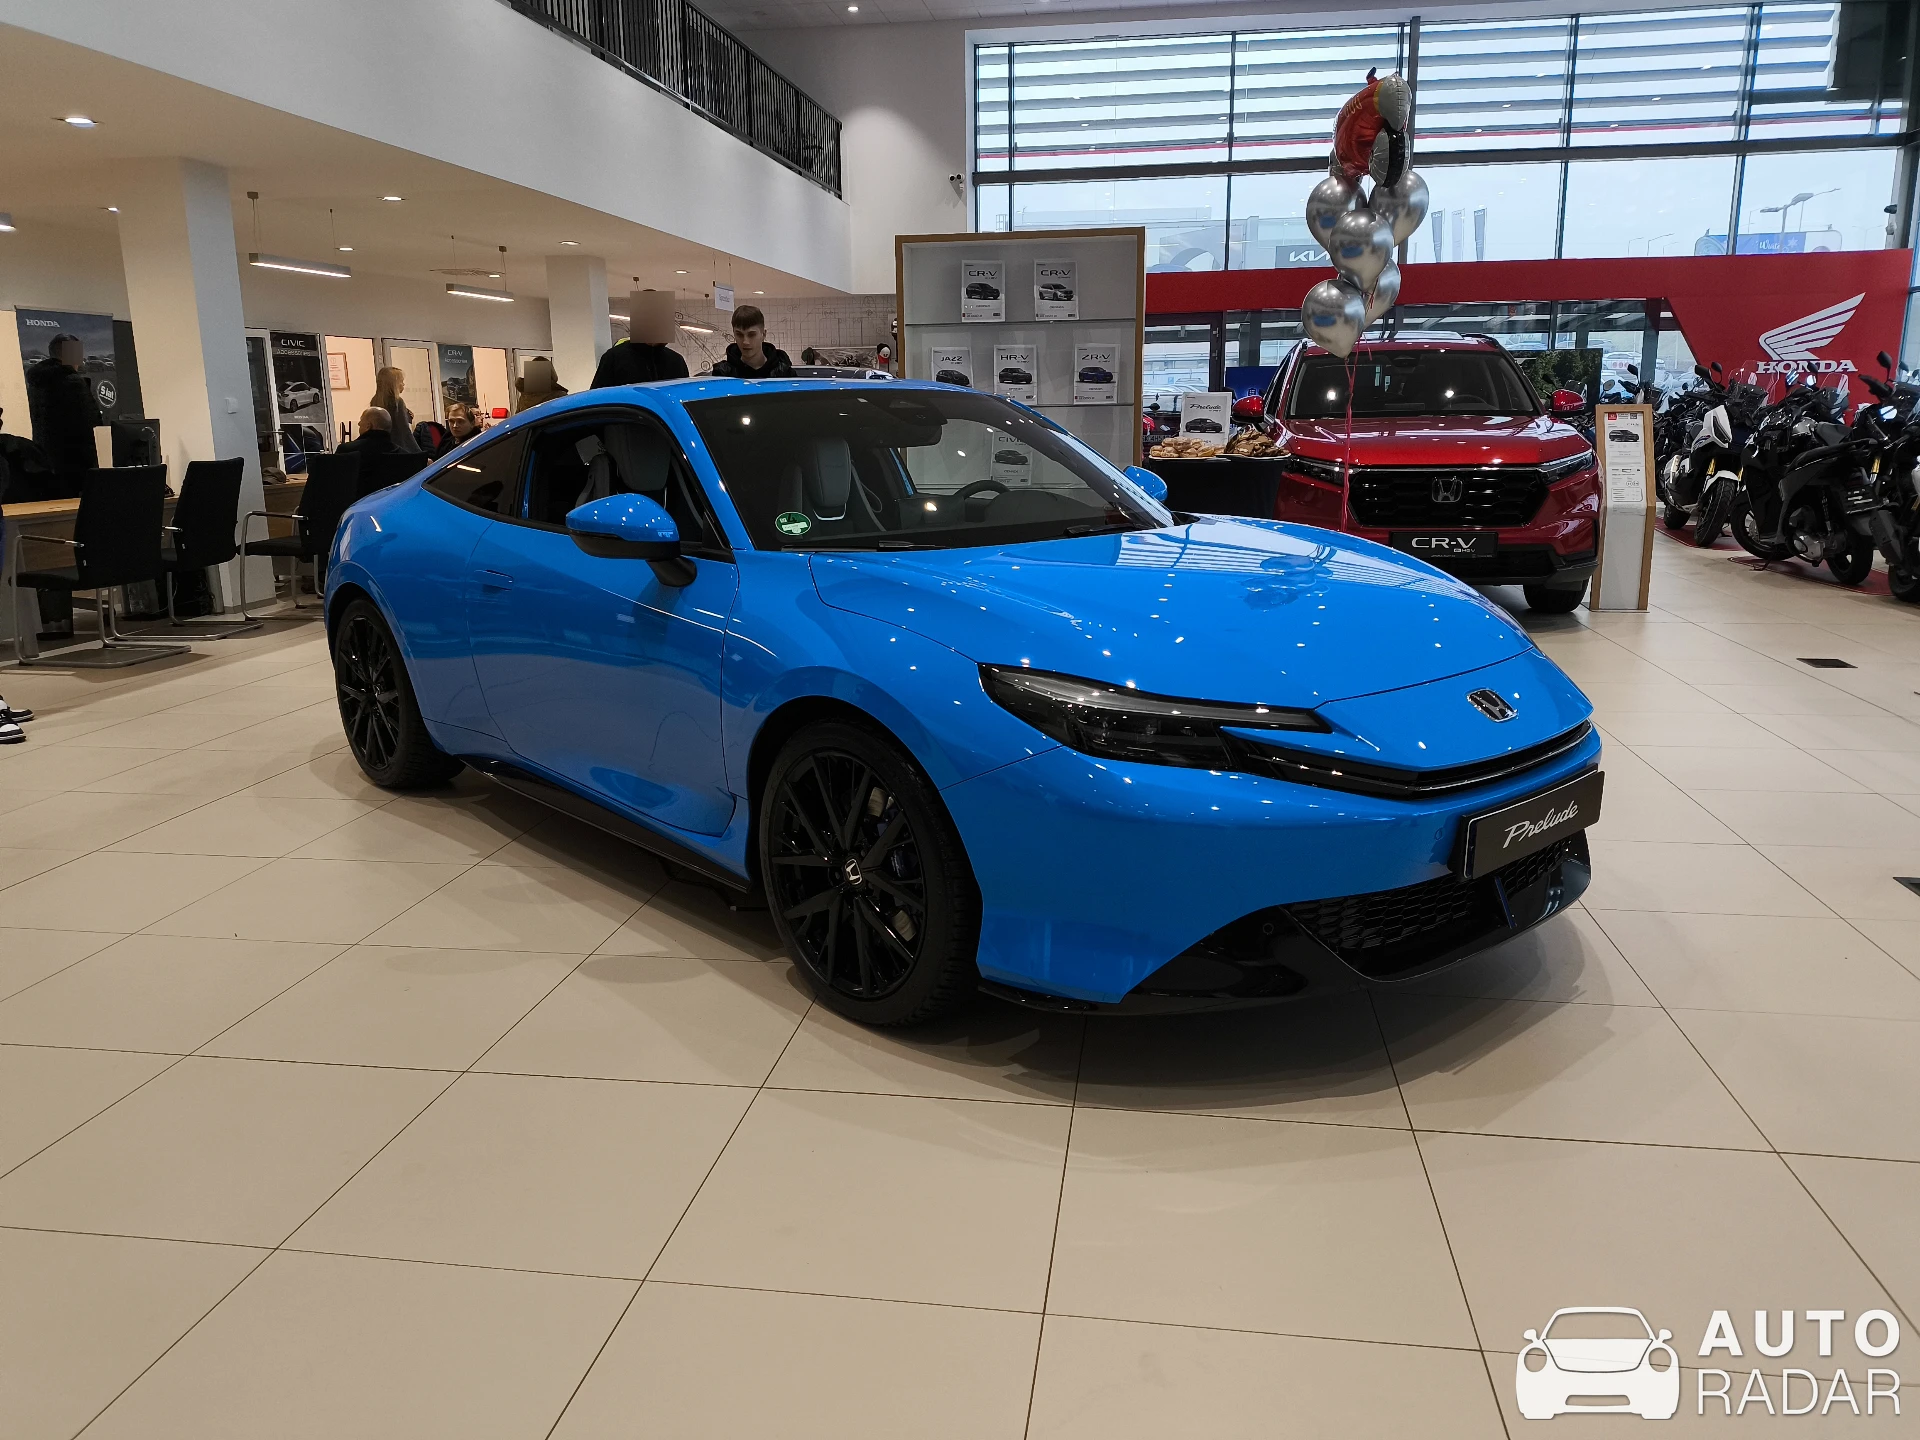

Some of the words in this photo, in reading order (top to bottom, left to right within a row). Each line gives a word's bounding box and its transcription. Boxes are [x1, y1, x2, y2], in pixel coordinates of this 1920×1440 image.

[25, 318, 61, 328] HONDA
[281, 338, 306, 348] CIVIC
[1756, 359, 1858, 374] HONDA
[1411, 537, 1477, 549] CR-V
[1502, 800, 1579, 849] Prelude
